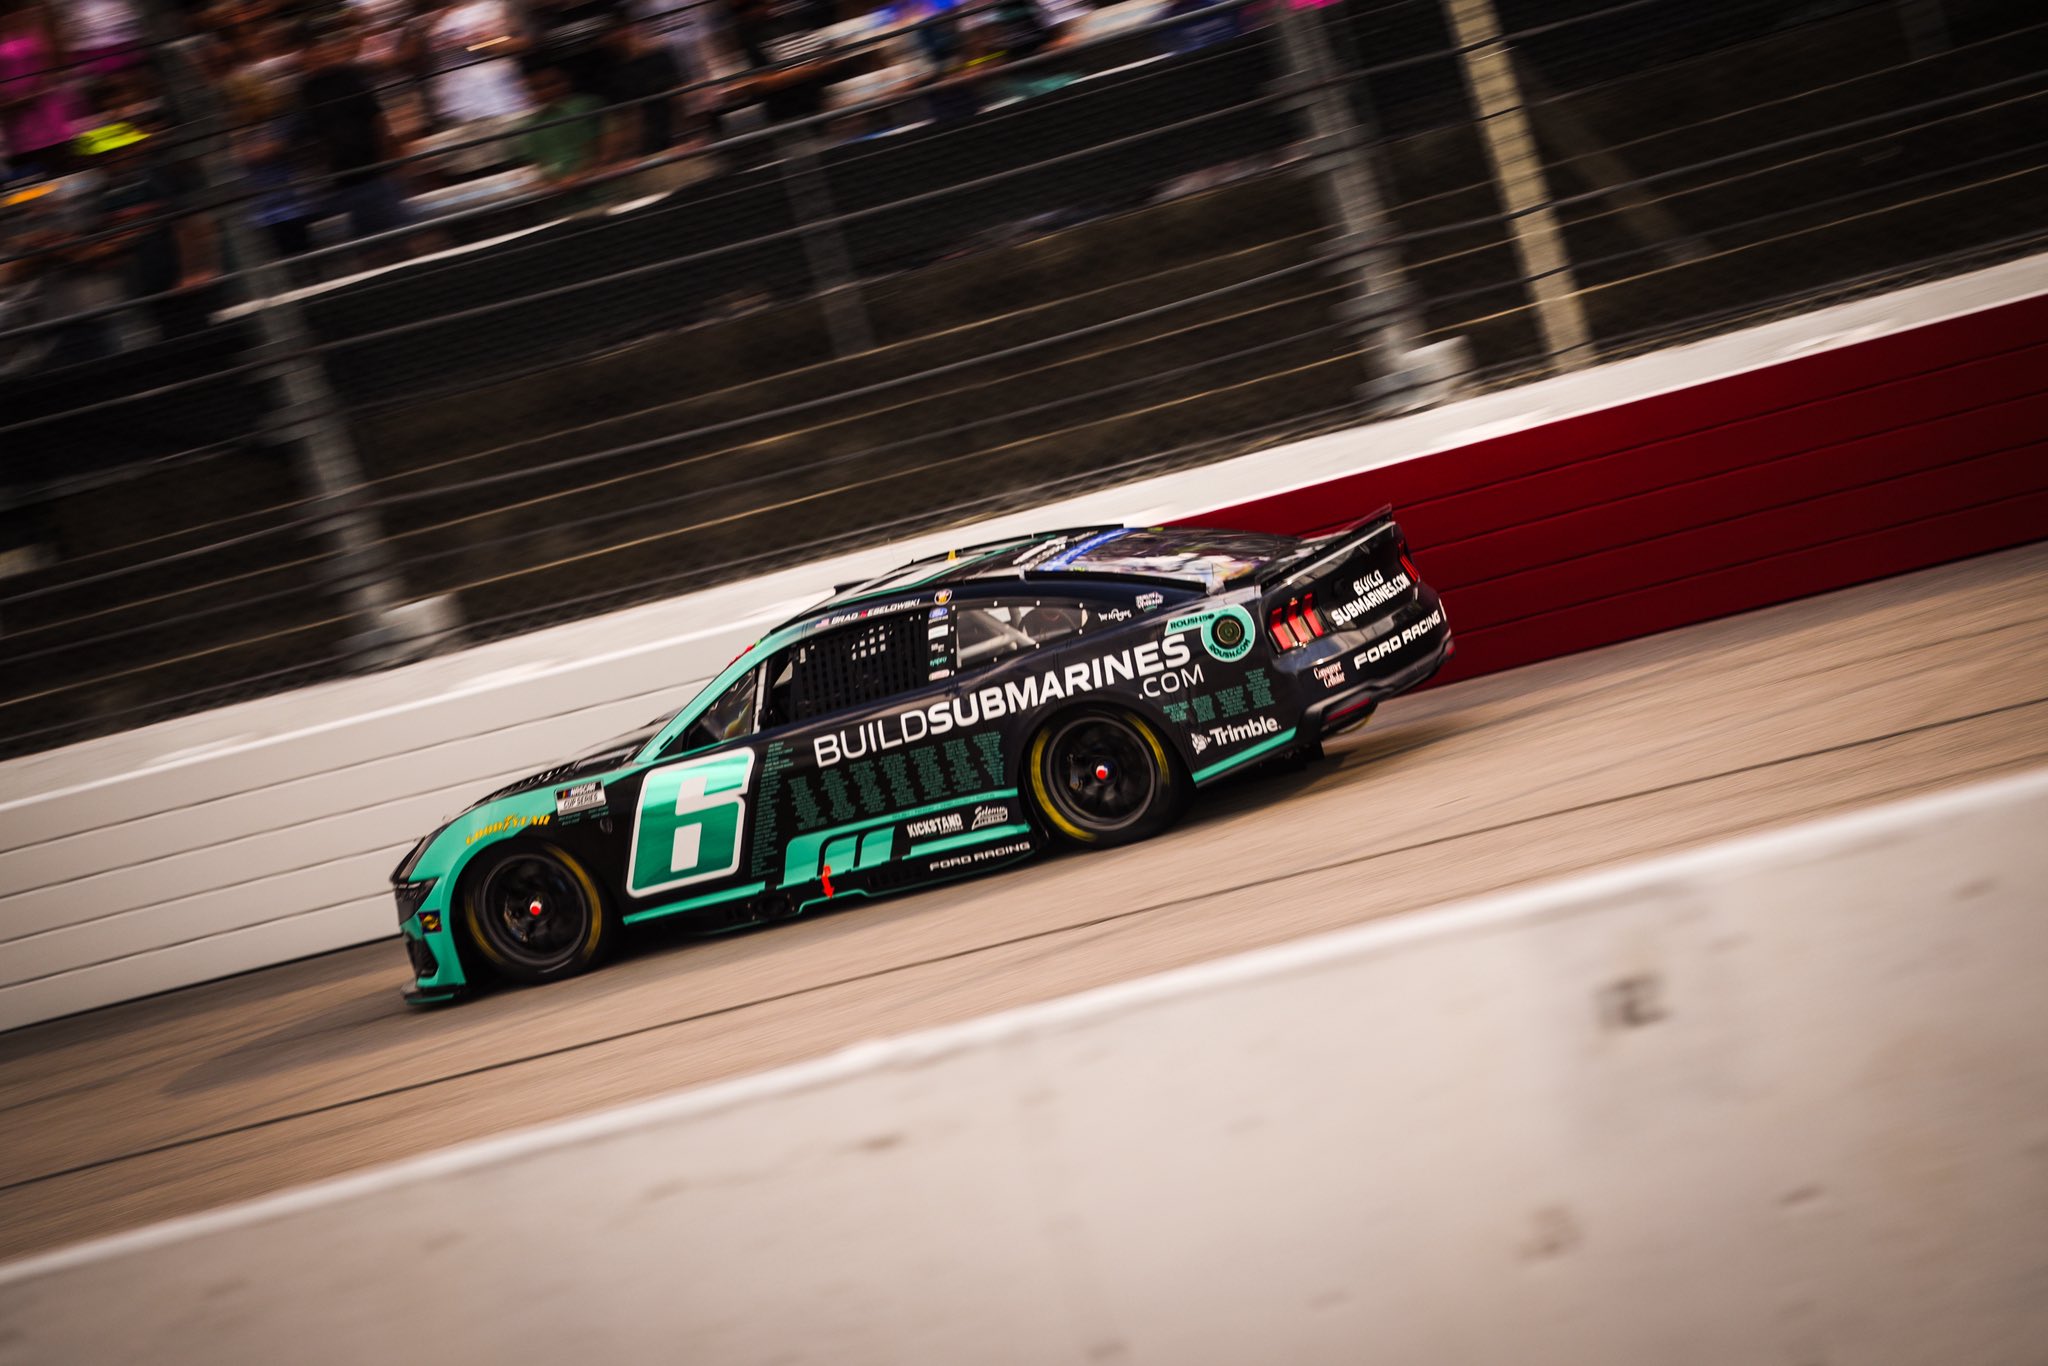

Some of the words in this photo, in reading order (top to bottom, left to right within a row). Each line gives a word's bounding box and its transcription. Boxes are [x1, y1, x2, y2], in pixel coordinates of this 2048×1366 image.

[1353, 569, 1384, 597] BUILD
[1331, 572, 1411, 627] SUBMARINES.COM
[831, 613, 858, 625] BRAD
[1209, 638, 1251, 659] ROUSH.COM
[1353, 635, 1402, 670] FORD
[1401, 609, 1441, 645] RACING
[1138, 664, 1205, 700] .COM
[570, 783, 597, 797] NASCAR
[626, 746, 756, 898] 6
[906, 813, 963, 839] KICKSTAND
[929, 857, 972, 872] FORD
[973, 841, 1031, 862] RACING
